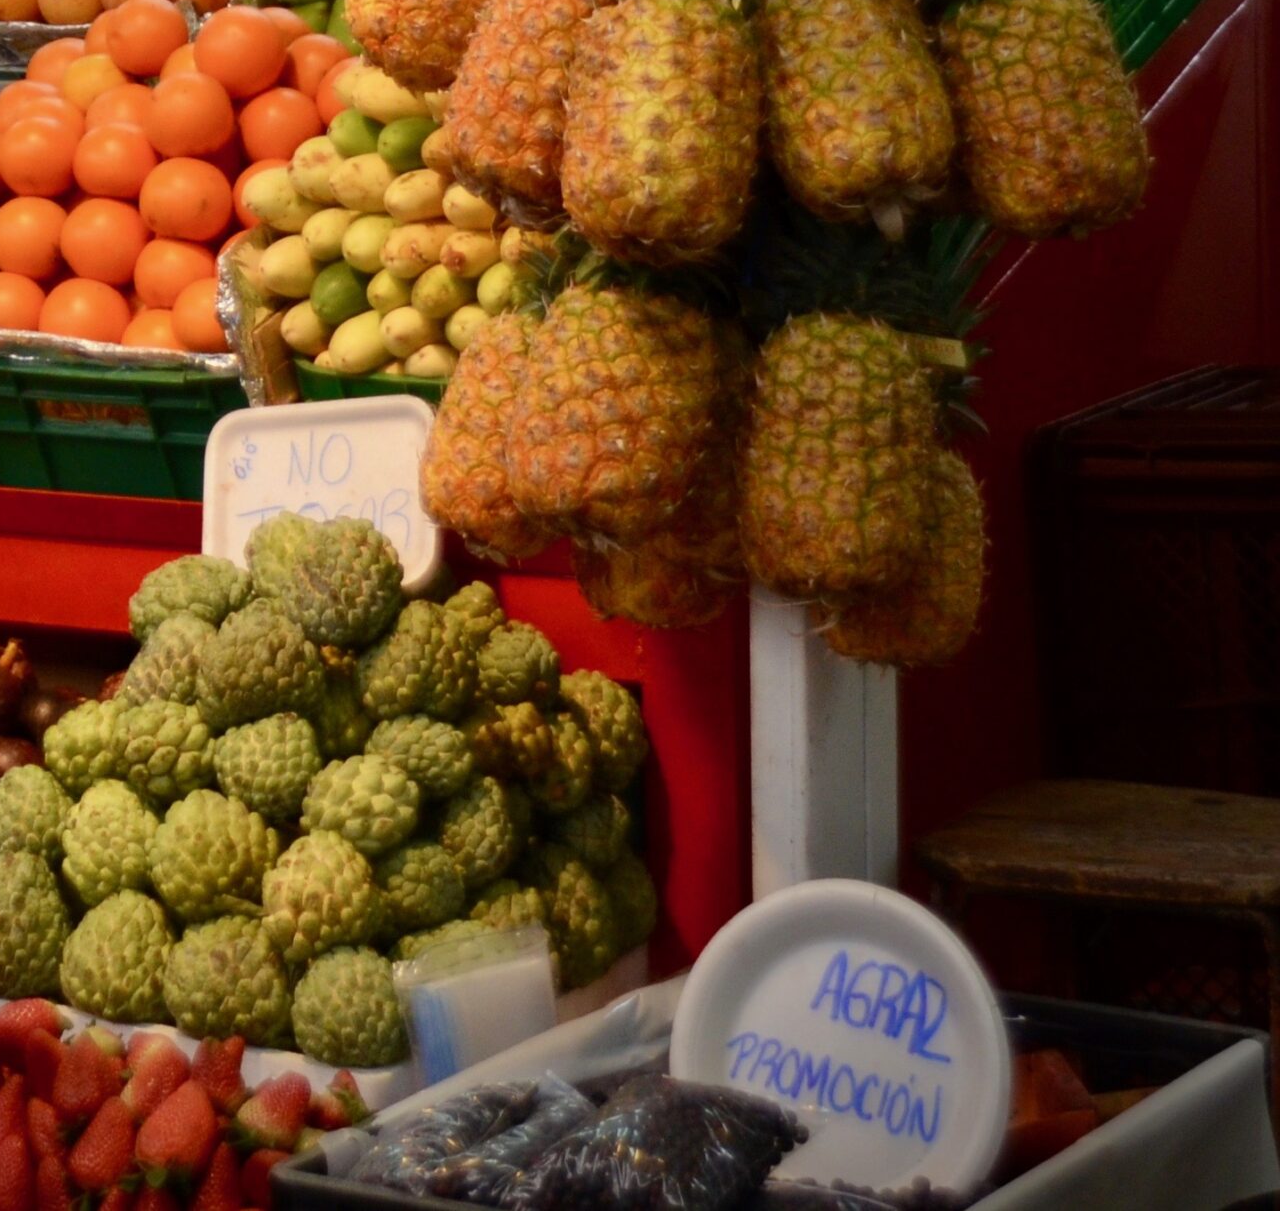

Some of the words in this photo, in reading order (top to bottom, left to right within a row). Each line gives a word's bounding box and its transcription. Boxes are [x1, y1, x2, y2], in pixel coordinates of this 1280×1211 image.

[287, 430, 353, 486] NO
[235, 488, 411, 549] TAR
[809, 949, 952, 1064] AGRAZ
[726, 1031, 944, 1144] PROMOCIÓN
